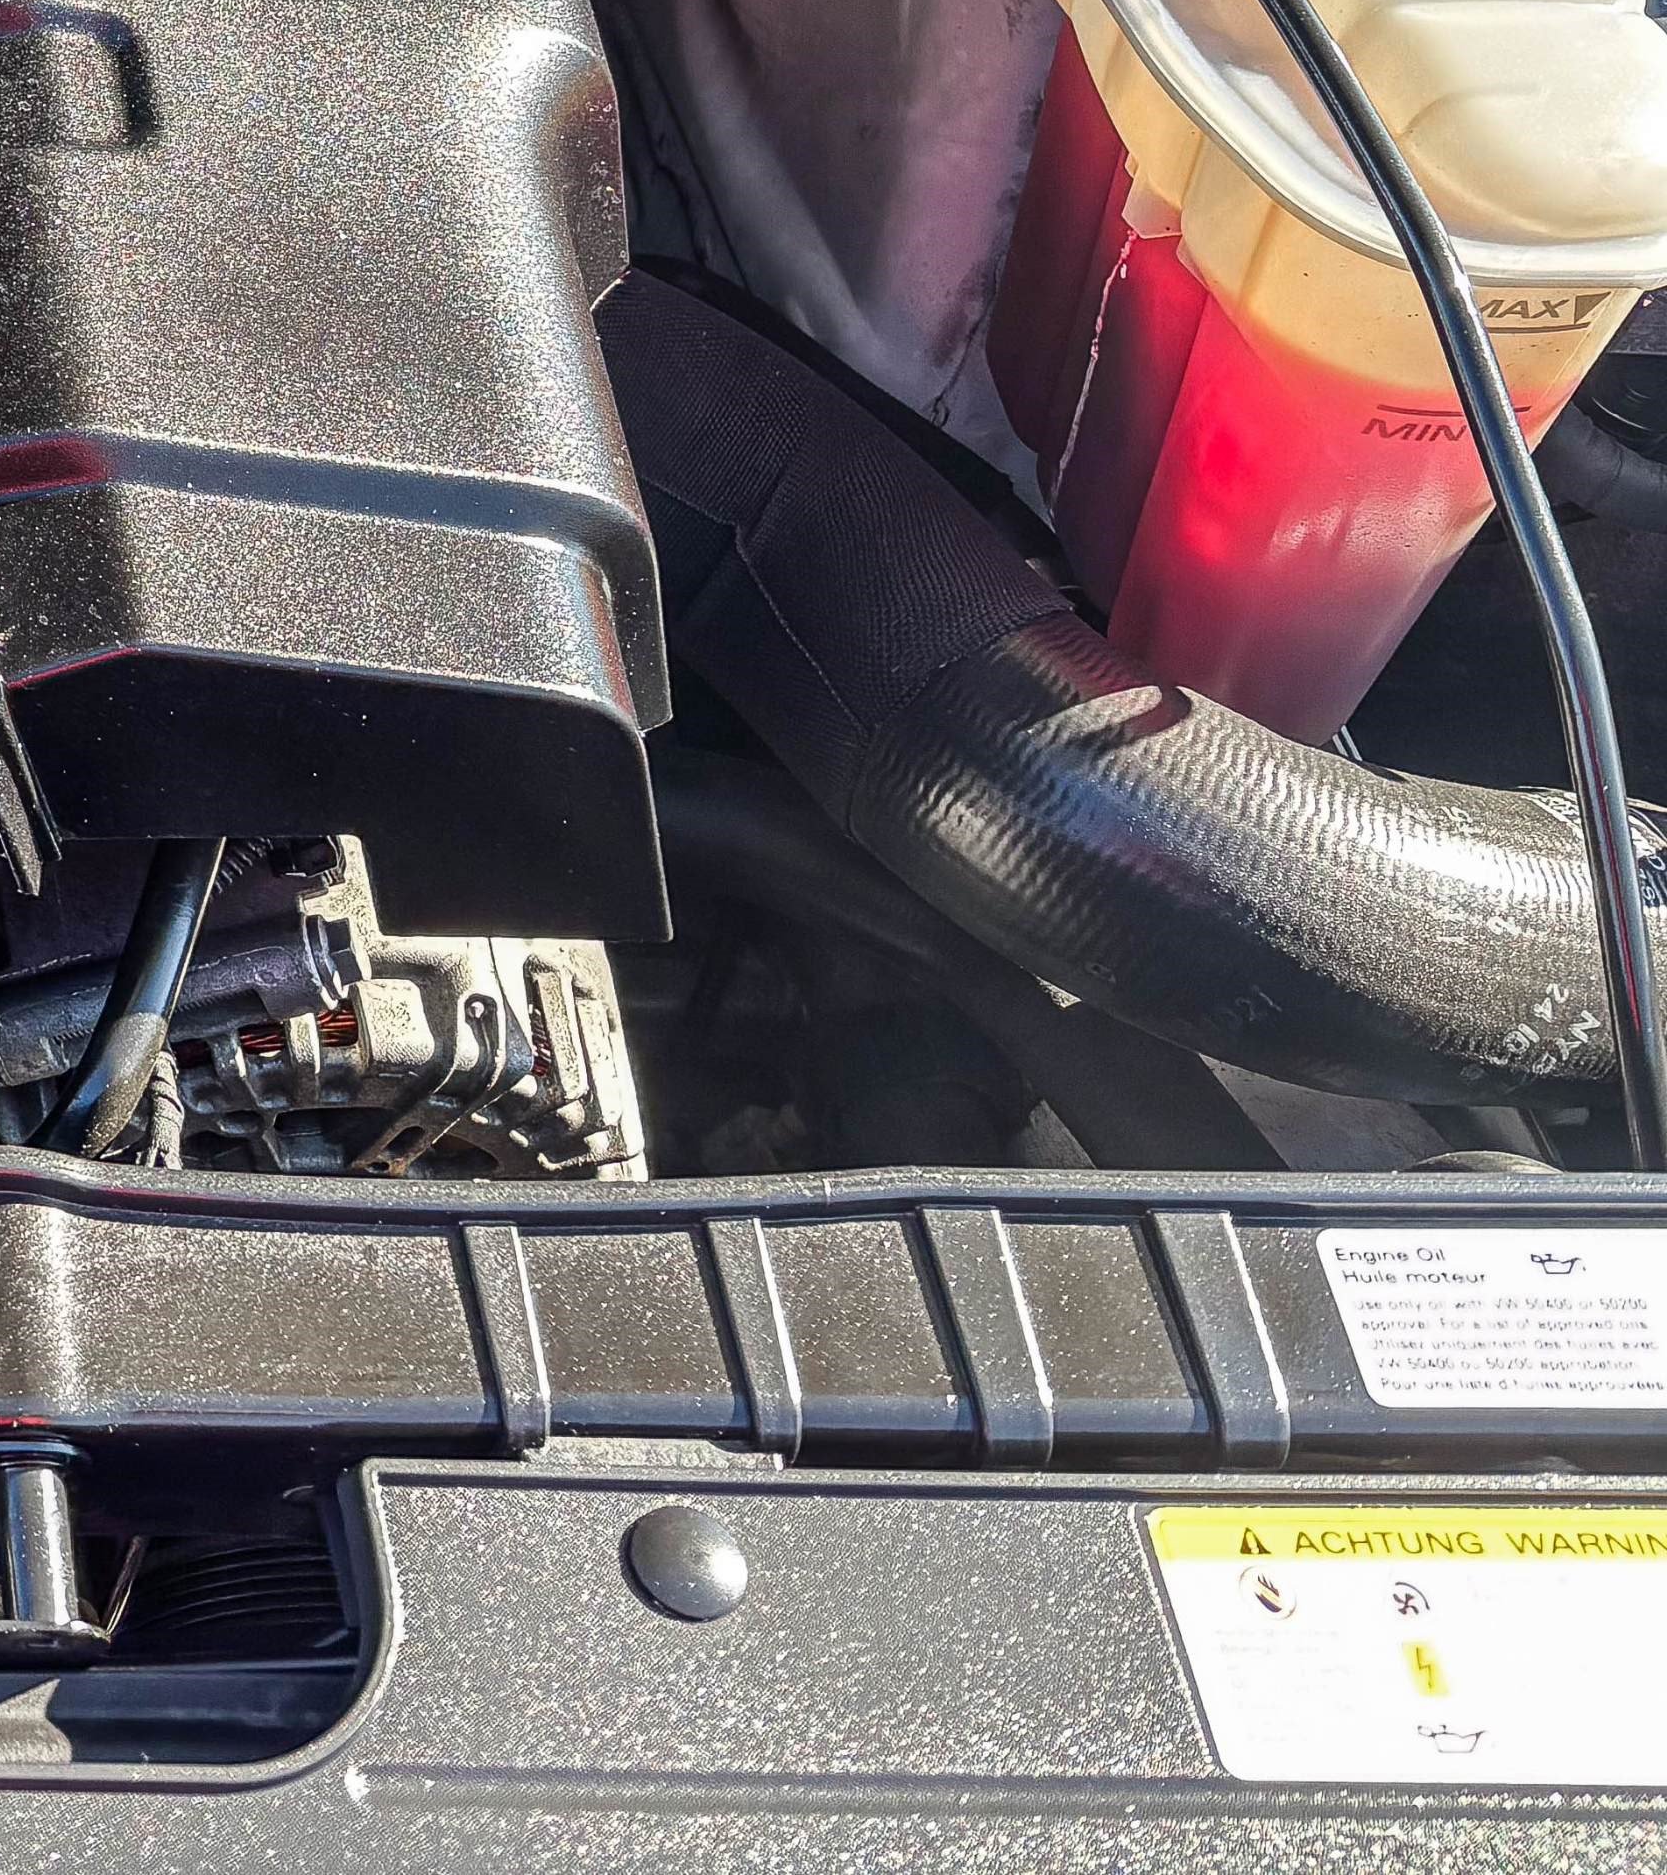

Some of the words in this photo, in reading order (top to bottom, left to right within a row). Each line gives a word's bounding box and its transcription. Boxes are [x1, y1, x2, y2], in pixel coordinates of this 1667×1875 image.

[1362, 418, 1468, 442] MIN
[1334, 1247, 1409, 1265] Engine
[1416, 1247, 1445, 1263] Oil
[1343, 1269, 1398, 1285] Huile
[1406, 1270, 1487, 1285] moteur
[1294, 1530, 1486, 1556] ACHTUNG
